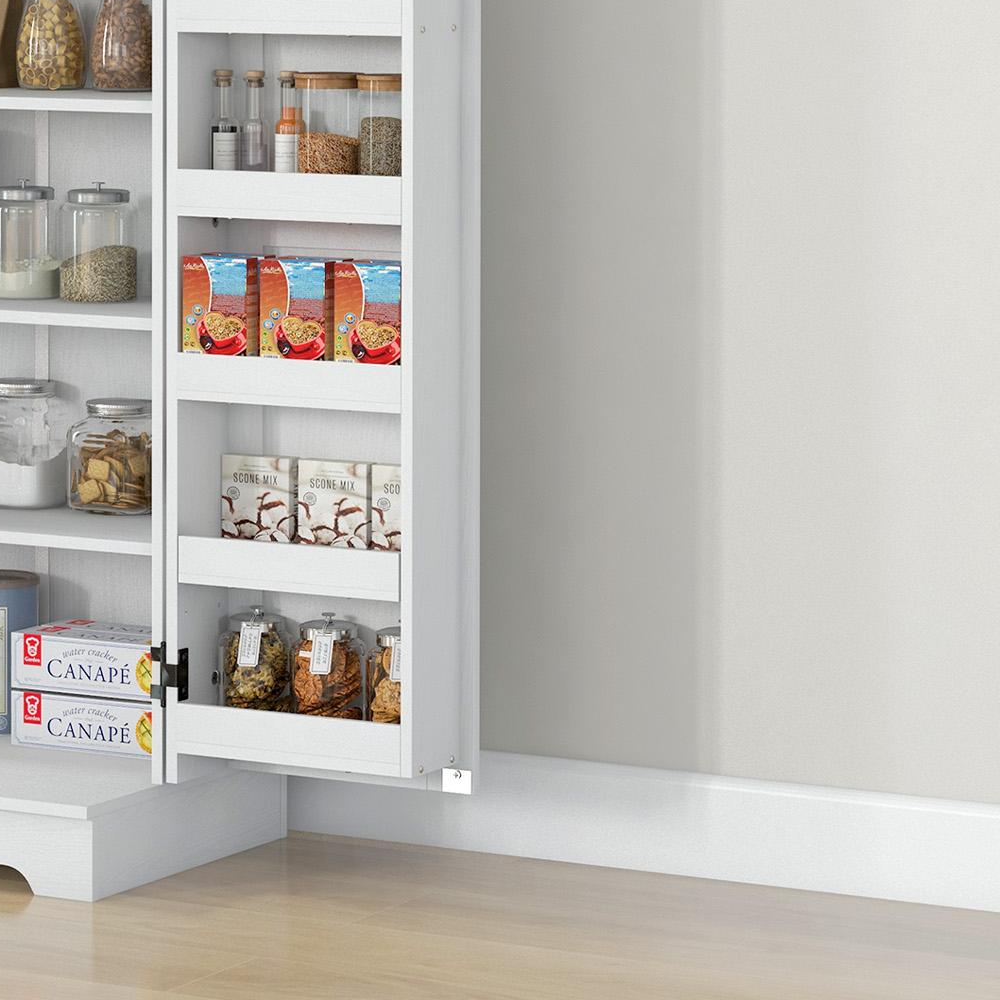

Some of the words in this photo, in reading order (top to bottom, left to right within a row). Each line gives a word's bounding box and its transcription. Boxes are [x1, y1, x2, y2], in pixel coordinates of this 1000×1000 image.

[232, 472, 260, 485] SCONE
[262, 475, 278, 486] MIX
[309, 477, 337, 491] SCONE
[340, 480, 356, 492] MIX
[62, 648, 85, 659] water
[87, 648, 118, 664] cracker
[47, 658, 131, 685] CANAPÉ
[62, 706, 85, 718] water
[87, 707, 118, 722] cracker
[47, 717, 131, 744] CANAPÉ
